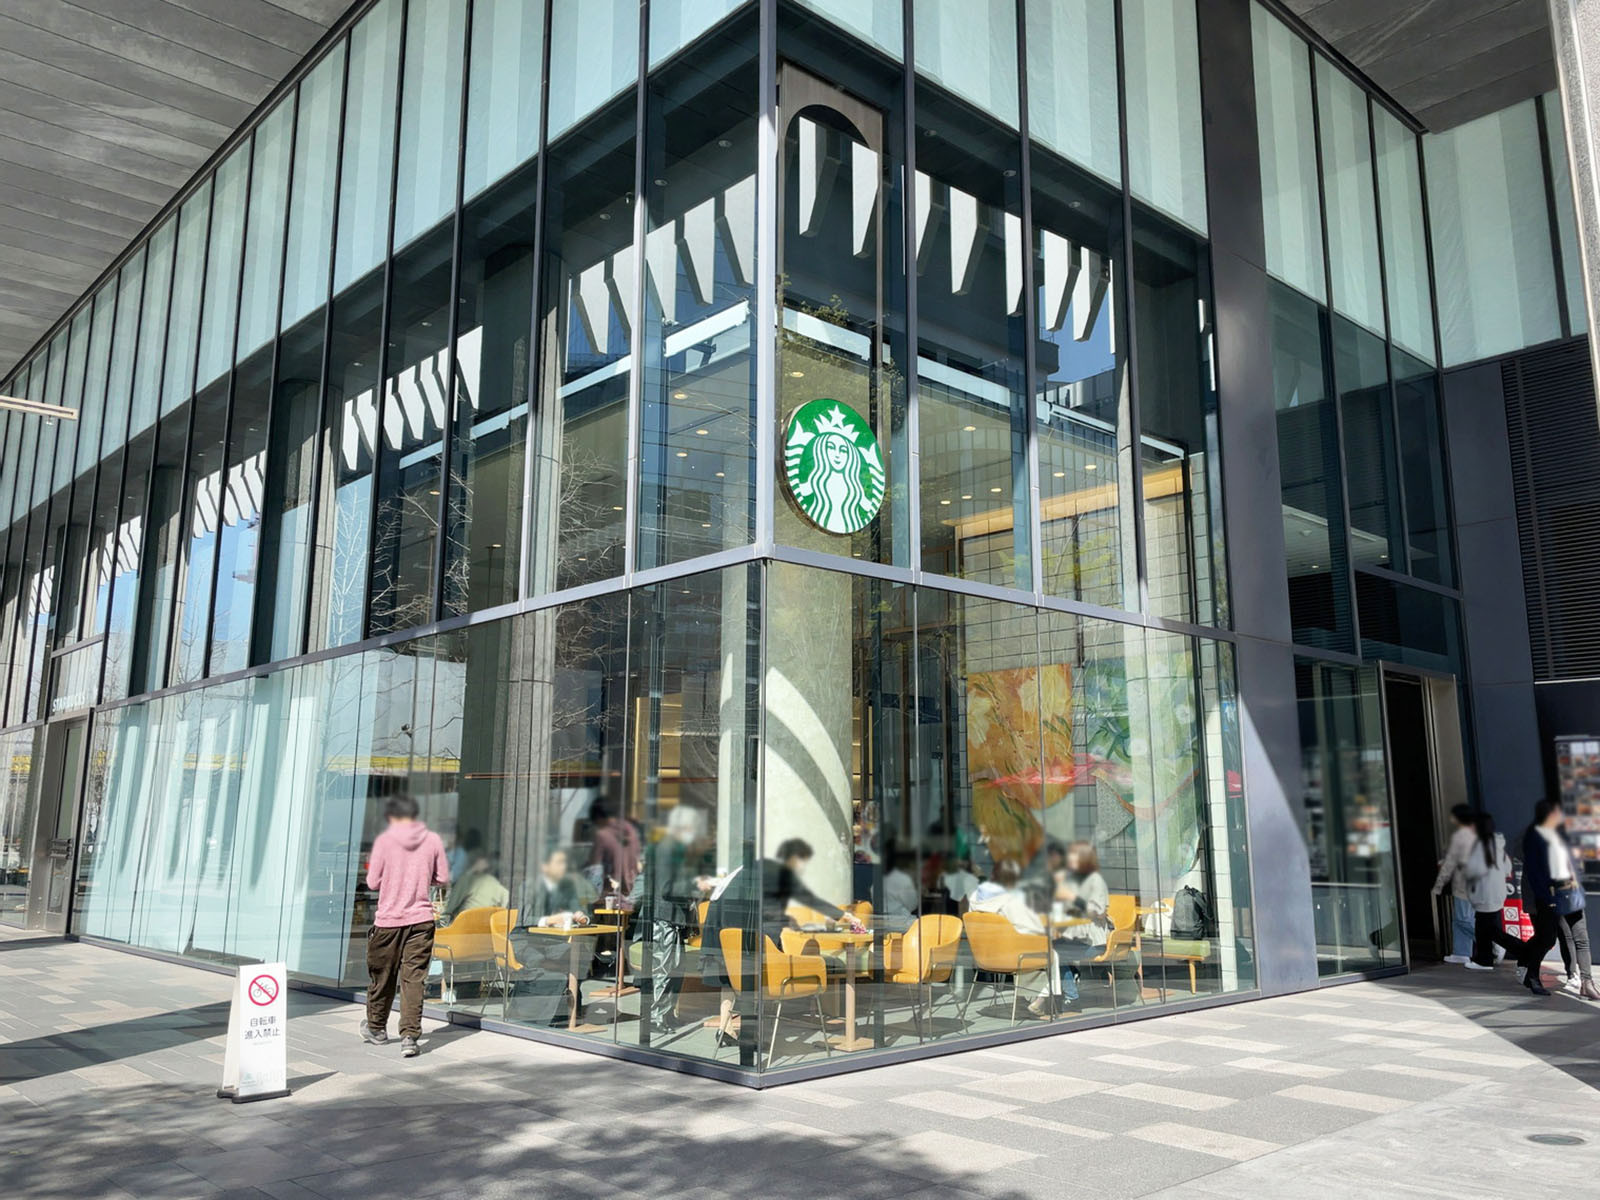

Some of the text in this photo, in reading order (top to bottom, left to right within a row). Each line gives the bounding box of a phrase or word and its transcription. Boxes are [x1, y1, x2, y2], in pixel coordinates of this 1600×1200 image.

[250, 1015, 276, 1027] 自転車
[244, 1027, 281, 1040] 進入禁止
